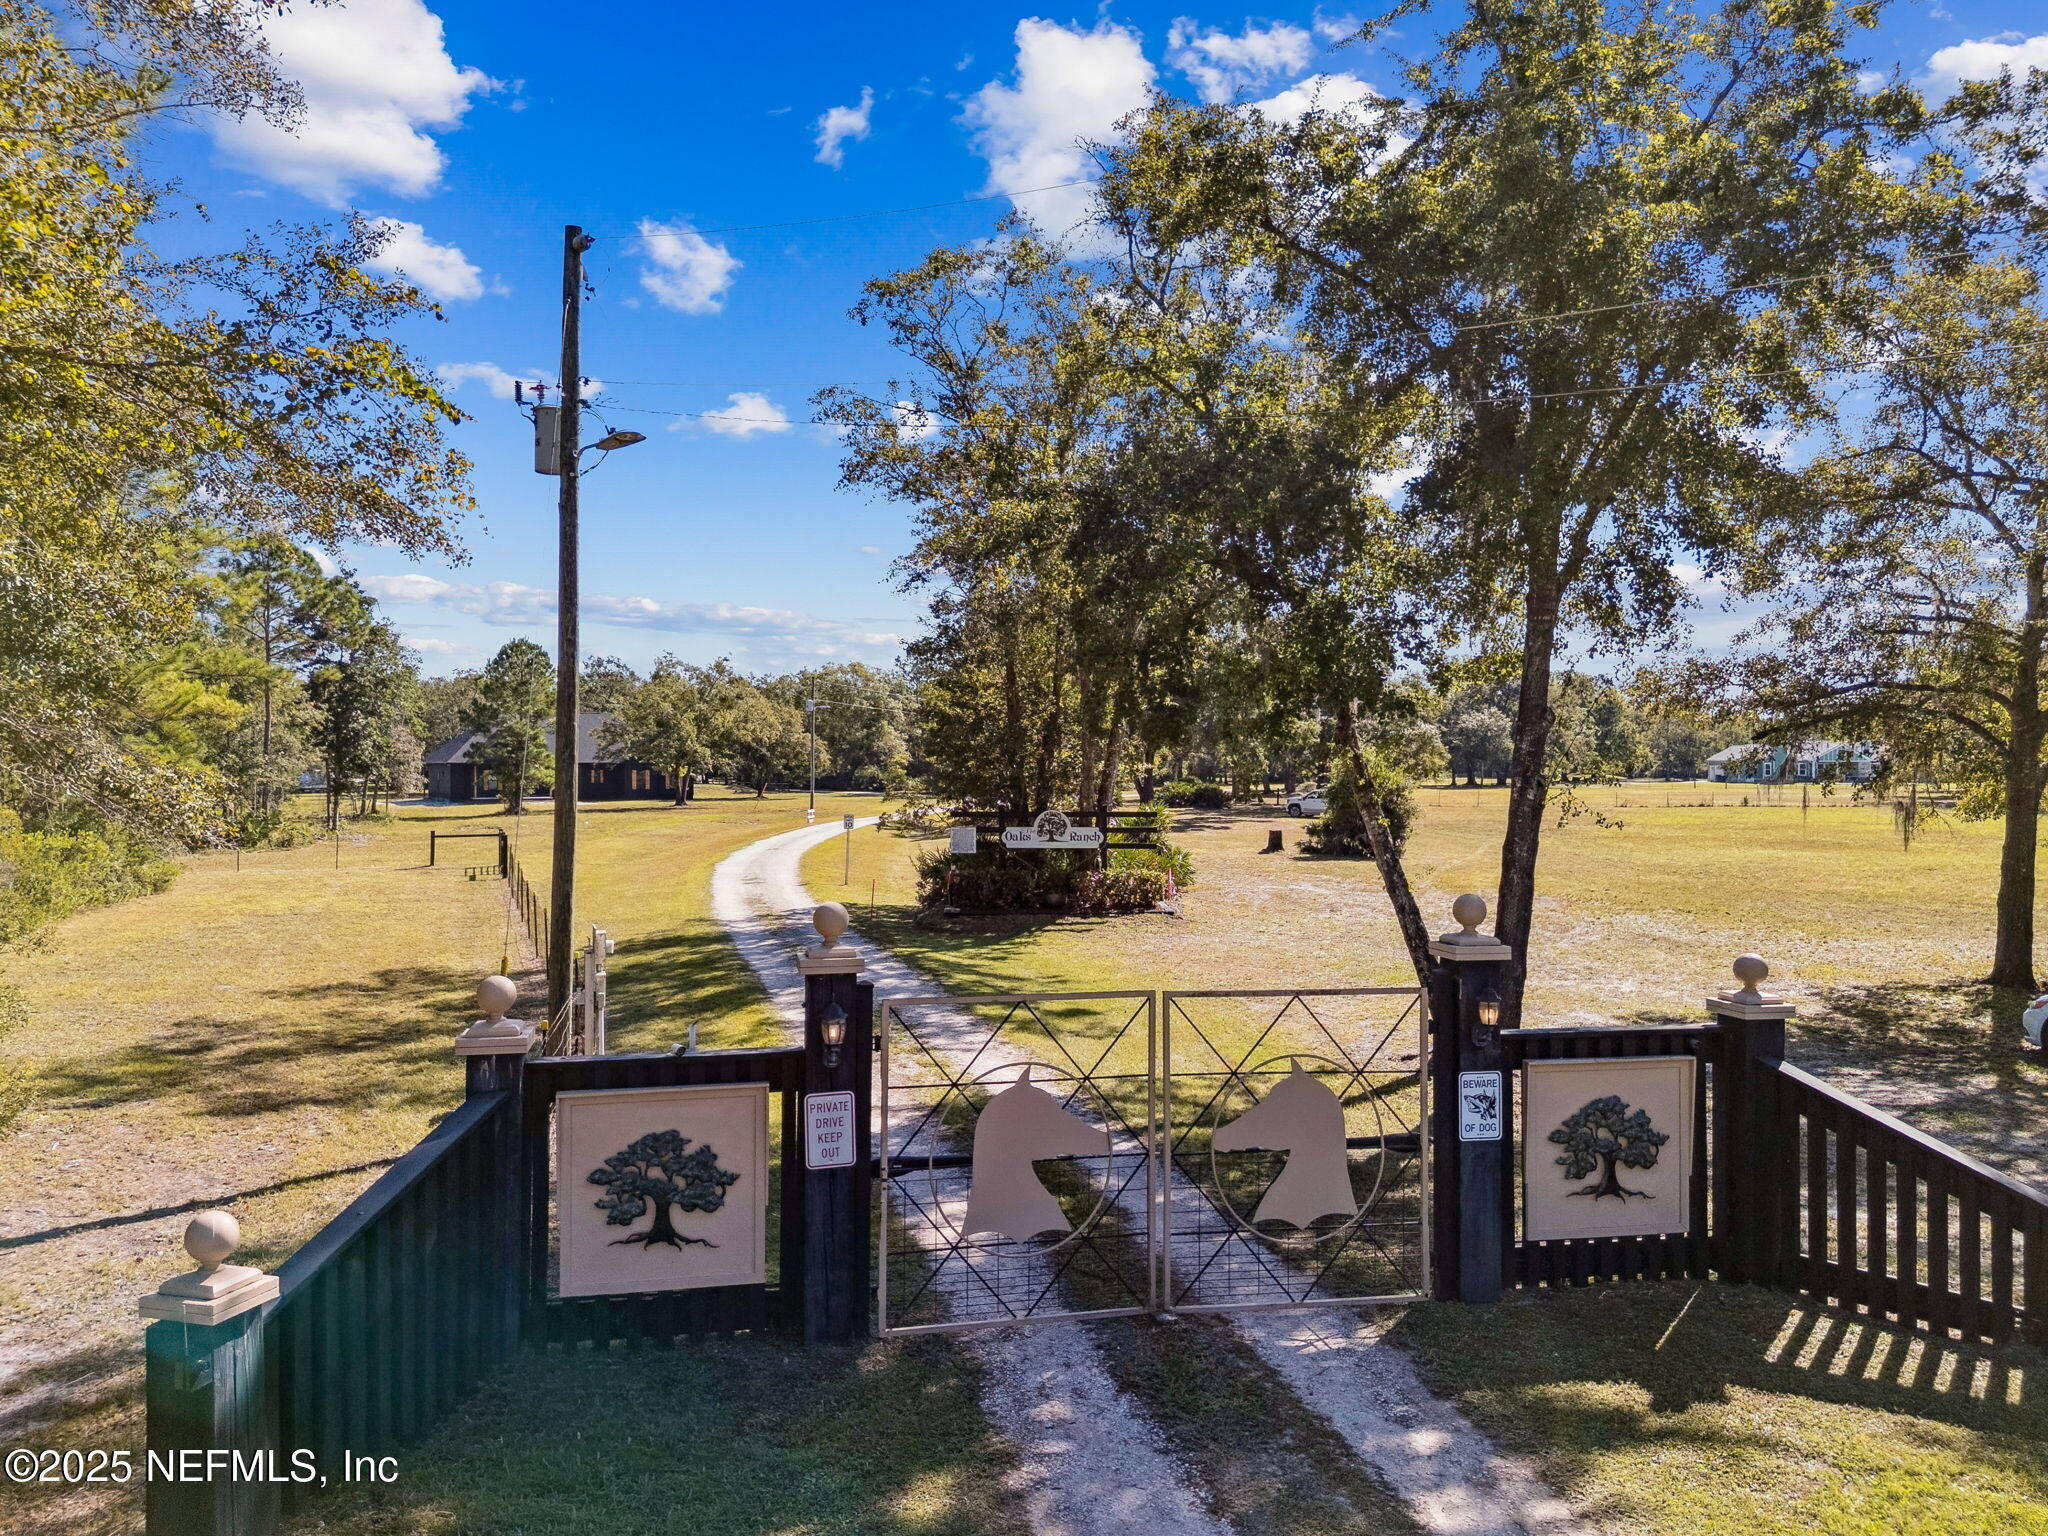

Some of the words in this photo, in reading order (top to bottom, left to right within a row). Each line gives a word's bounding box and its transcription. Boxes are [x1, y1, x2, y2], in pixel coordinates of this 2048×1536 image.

[1005, 831, 1031, 841] Oaks
[1070, 831, 1100, 842] Ranch
[1463, 1079, 1498, 1089] BEWARE
[809, 1101, 850, 1114] PRIVATE
[816, 1117, 844, 1128] DRIVE
[1464, 1123, 1476, 1133] OF
[1479, 1122, 1497, 1132] DOG
[817, 1132, 843, 1144] KEEP
[821, 1147, 840, 1158] OUT
